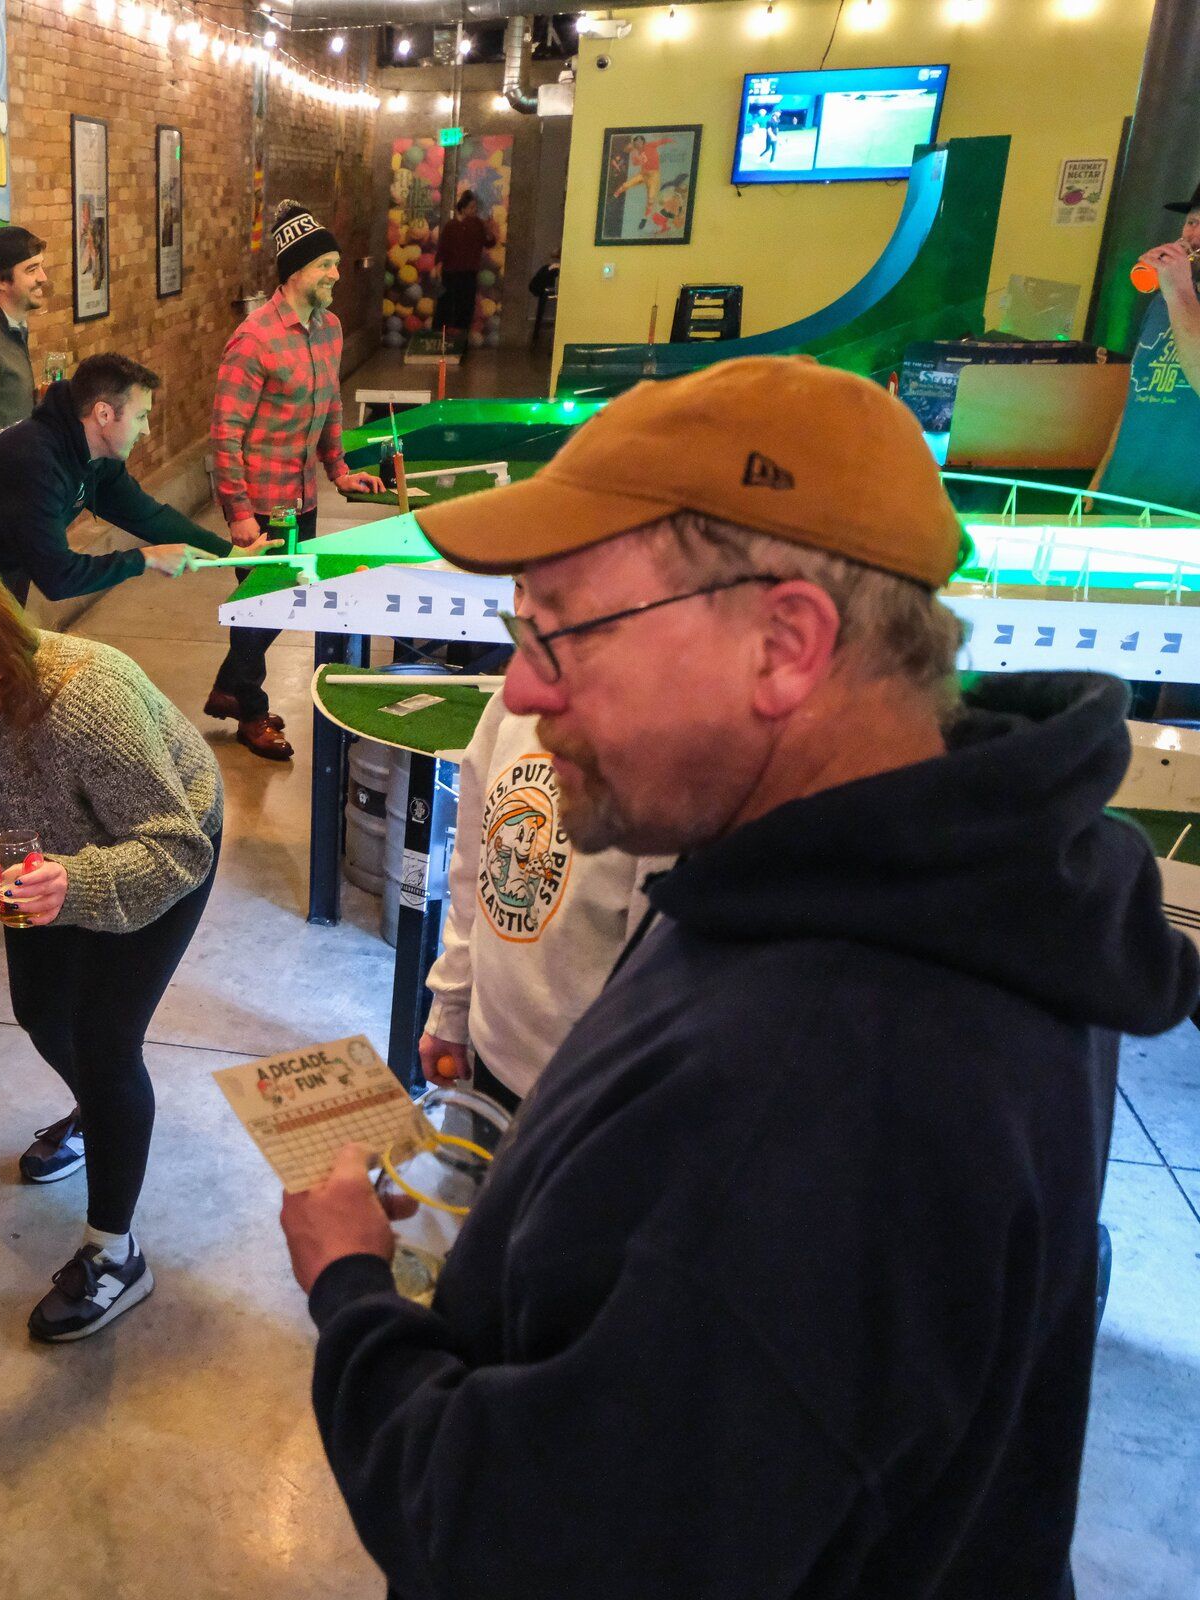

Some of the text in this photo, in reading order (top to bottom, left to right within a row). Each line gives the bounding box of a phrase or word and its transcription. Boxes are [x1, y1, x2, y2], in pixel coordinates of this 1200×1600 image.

[1067, 170, 1101, 178] NECTAR
[1068, 163, 1102, 171] FAIRWAY
[257, 1067, 270, 1080] A
[268, 1051, 331, 1079] DECADE
[295, 1072, 327, 1092] FUN
